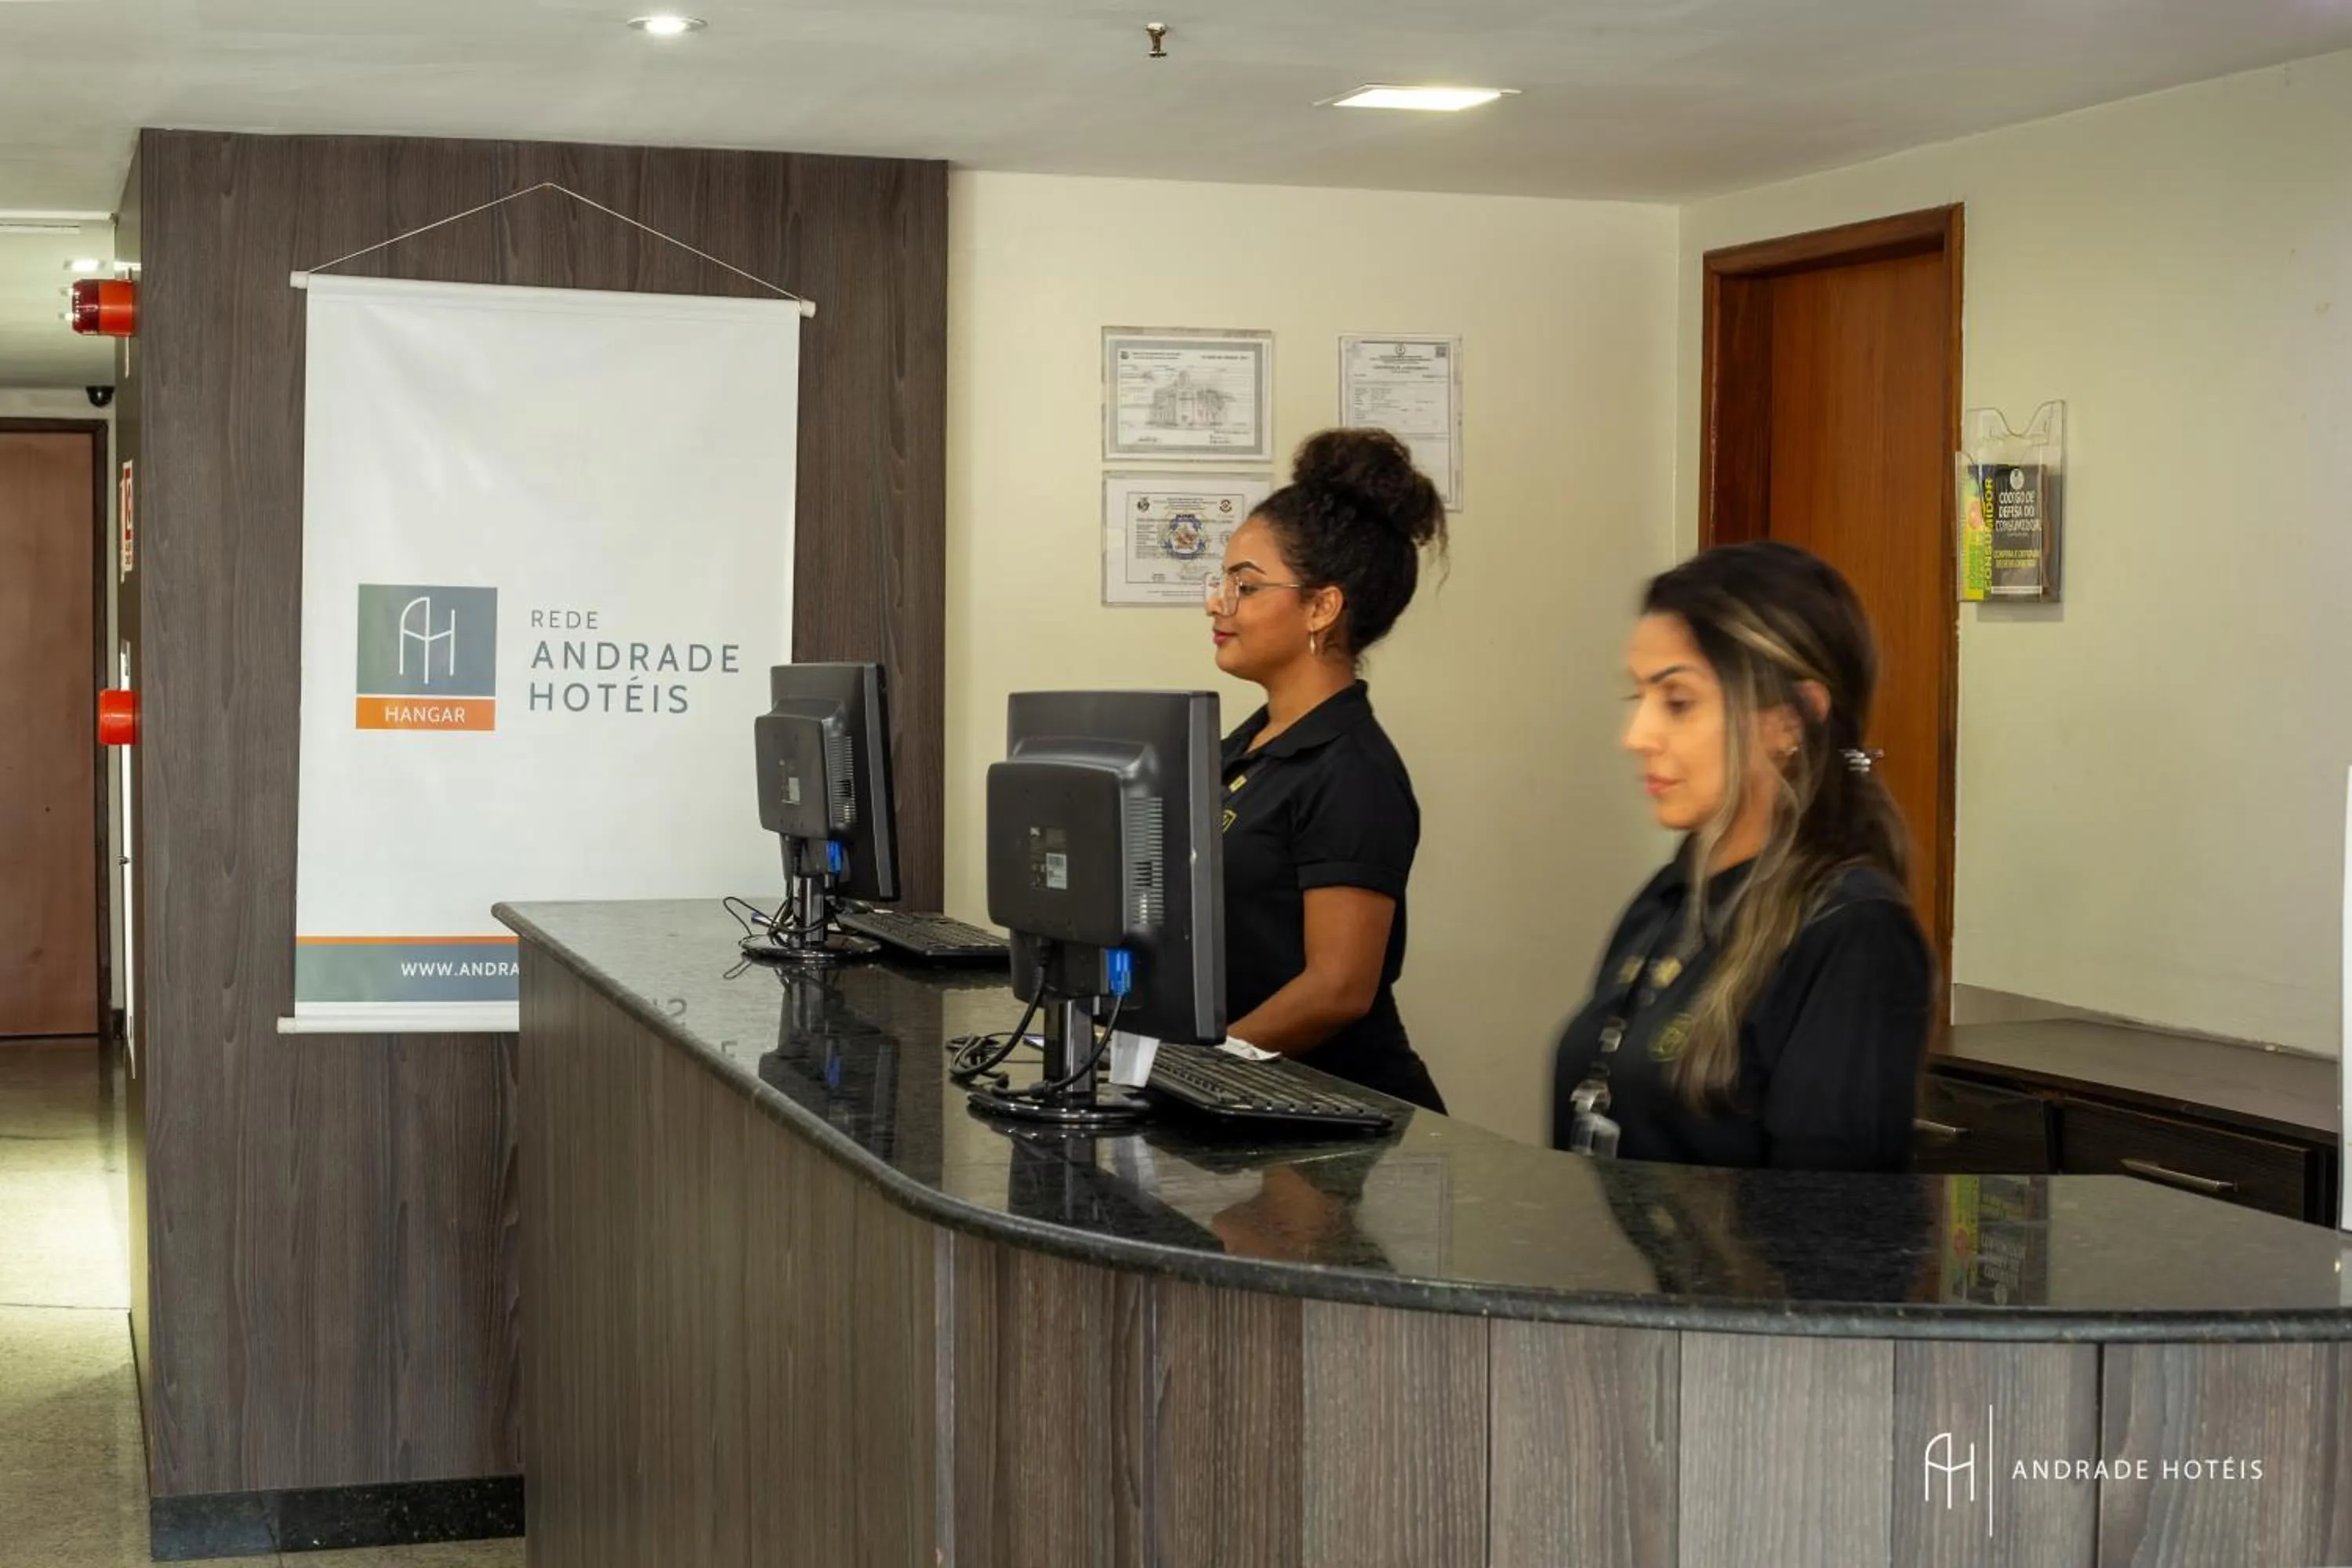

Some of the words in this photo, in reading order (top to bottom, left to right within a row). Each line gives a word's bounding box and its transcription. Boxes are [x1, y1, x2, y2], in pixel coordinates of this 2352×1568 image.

[530, 609, 599, 630] REDE
[531, 641, 740, 673] ANDRADE
[529, 675, 689, 713] HOTÉIS
[384, 706, 466, 723] HANGAR
